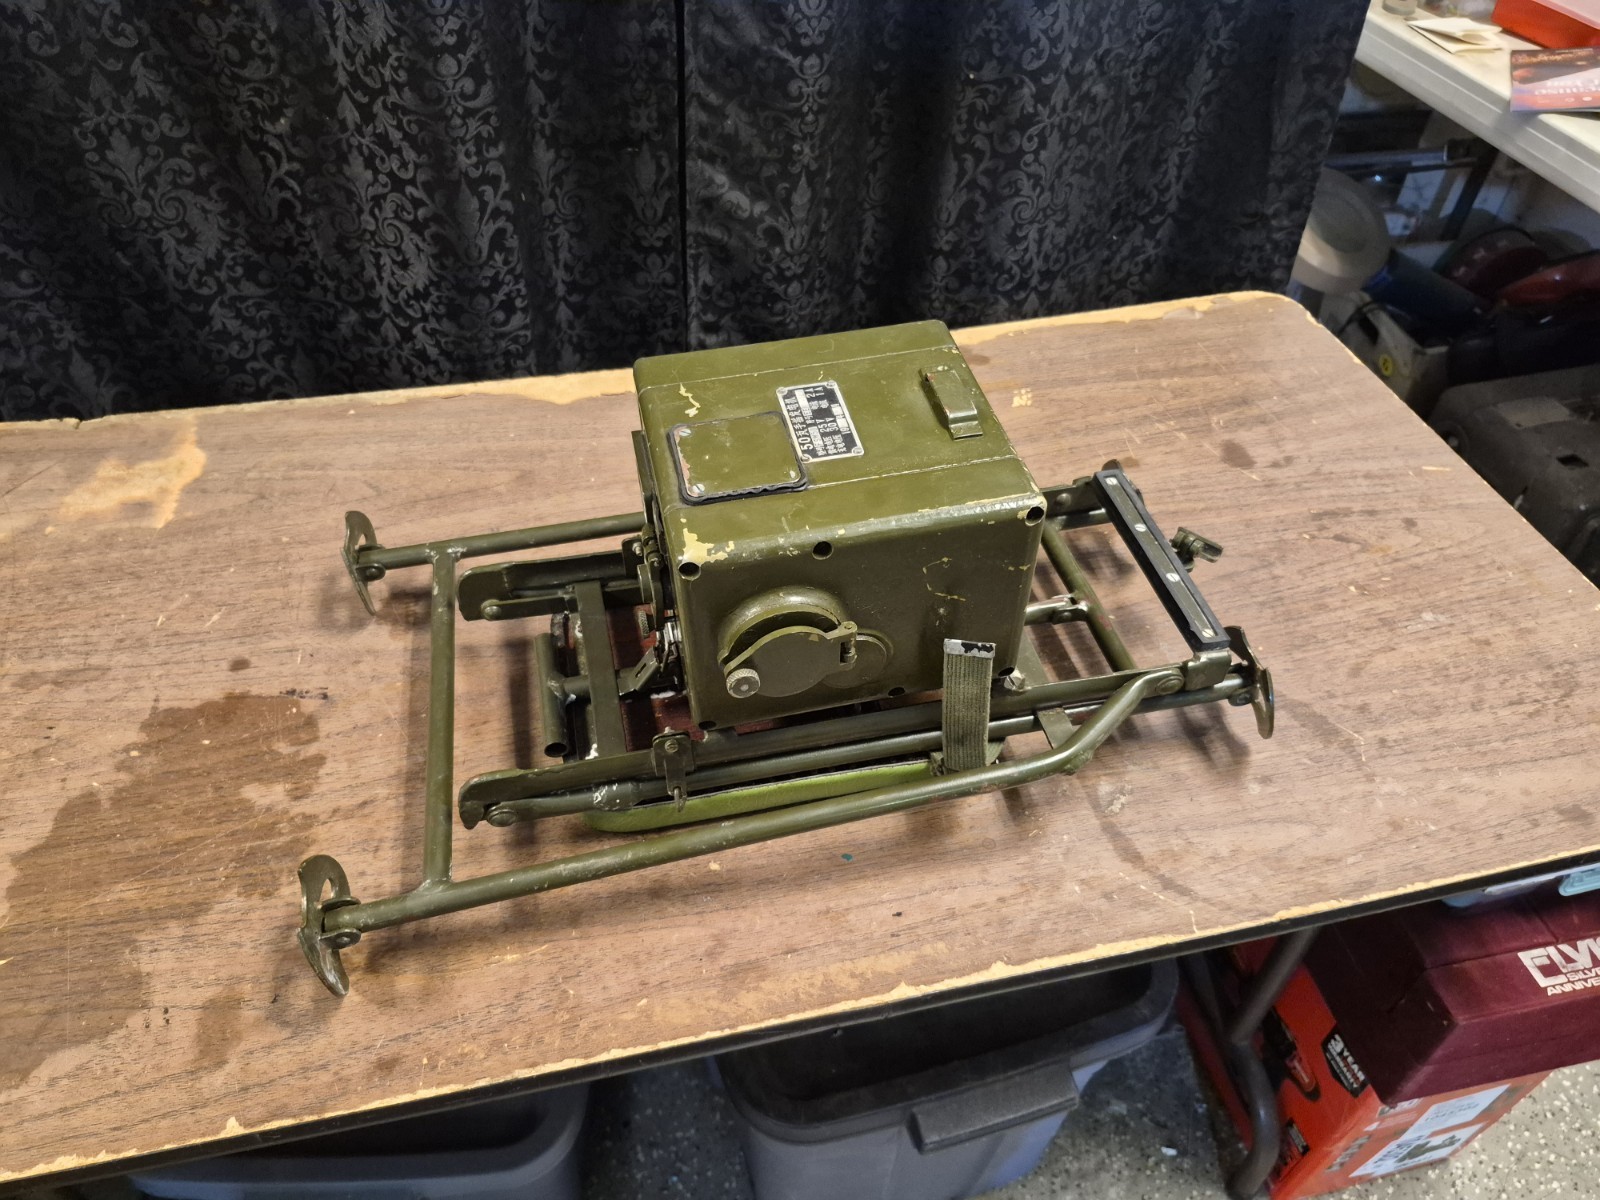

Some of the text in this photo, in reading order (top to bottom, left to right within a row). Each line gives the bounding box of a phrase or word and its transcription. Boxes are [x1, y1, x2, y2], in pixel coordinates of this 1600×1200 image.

[1517, 937, 1600, 987] ELVI
[1330, 1034, 1345, 1053] 3
[1343, 1048, 1365, 1081] YEAR
